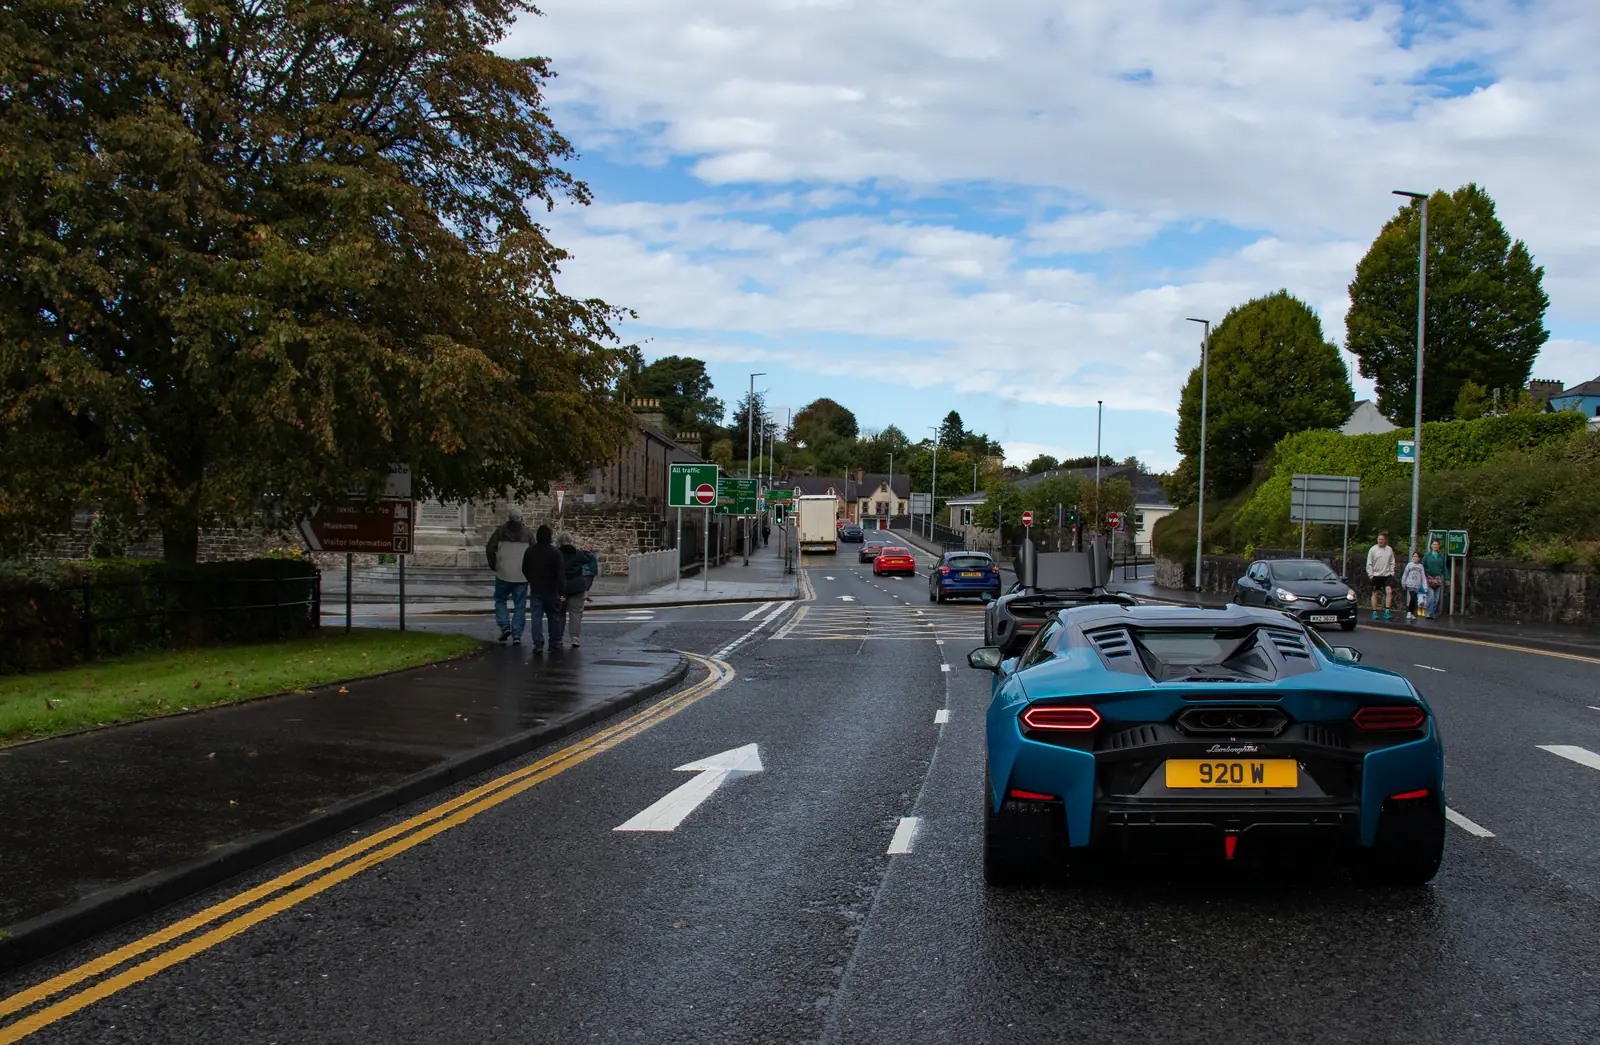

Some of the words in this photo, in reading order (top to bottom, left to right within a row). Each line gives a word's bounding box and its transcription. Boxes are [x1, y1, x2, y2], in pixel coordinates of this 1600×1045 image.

[323, 521, 358, 530] Museums
[323, 537, 347, 546] Visitor
[1199, 763, 1243, 784] 920
[1251, 763, 1264, 784] W
